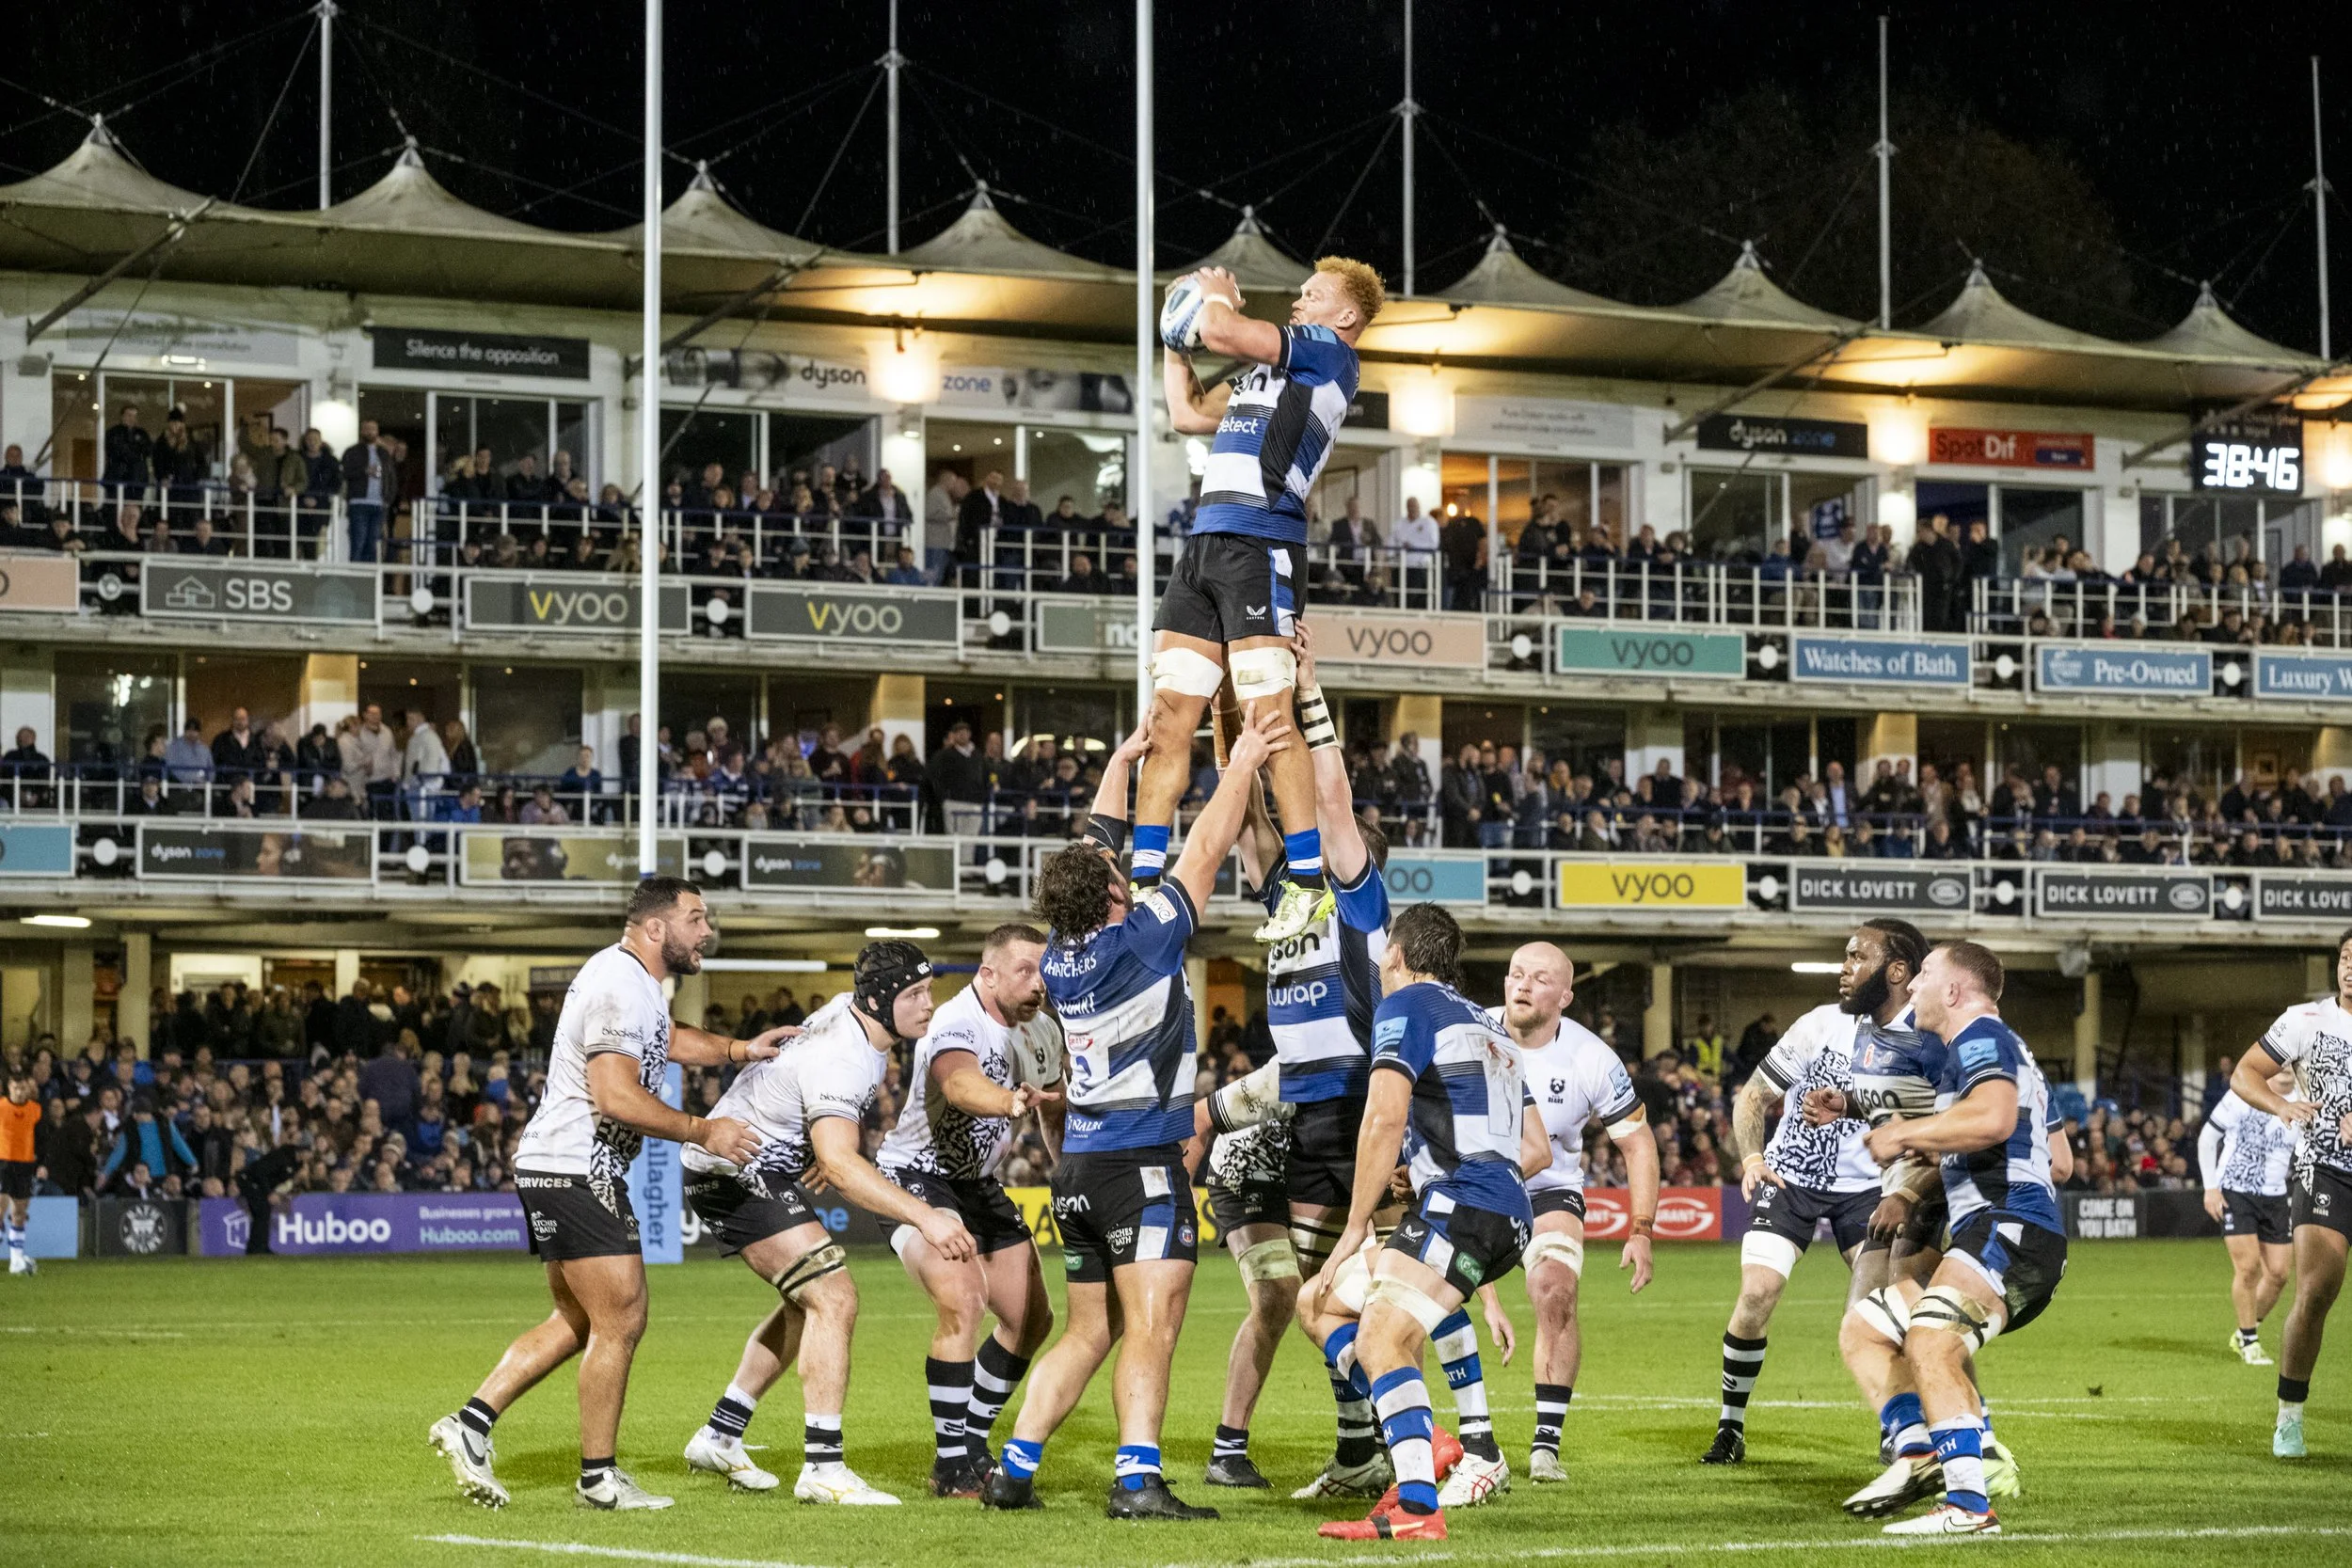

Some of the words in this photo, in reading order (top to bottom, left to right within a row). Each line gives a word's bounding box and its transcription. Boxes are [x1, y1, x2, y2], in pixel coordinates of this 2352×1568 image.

[405, 338, 457, 360] Silence
[459, 341, 483, 361] the
[485, 346, 559, 366] opposition
[802, 361, 866, 388] dyson
[943, 375, 991, 392] zone
[1729, 420, 1787, 449] dyson
[2202, 442, 2299, 491] 38:46
[225, 578, 293, 610] SBS
[529, 591, 628, 623] vyoo
[807, 601, 903, 635] vyoo
[1346, 626, 1433, 657] vyoo
[1612, 638, 1694, 669] vyoo
[1804, 646, 1883, 674] Watches
[1886, 650, 1910, 675] of
[1914, 651, 1958, 677] Bath
[2094, 658, 2198, 686] Pre-Owned
[2268, 664, 2334, 696] Luxury
[151, 842, 192, 863] dyson
[754, 854, 792, 874] dyson
[1388, 867, 1434, 895] oo
[1612, 872, 1694, 902] vyoo
[1801, 879, 1845, 898] DICK
[1849, 879, 1917, 900] LOVETT
[2046, 884, 2090, 904] DICK
[2093, 885, 2159, 905] LOVETT
[2264, 888, 2305, 908] DICK
[1043, 951, 1097, 978] THATCHERS
[643, 1135, 670, 1250] allagher
[1050, 1193, 1091, 1220] yson
[2079, 1198, 2115, 1218] COME
[278, 1212, 391, 1246] Huboo
[420, 1226, 520, 1244] Huboo.com
[531, 1218, 558, 1227] ATCHES
[1445, 1367, 1468, 1383] ATH
[1935, 1436, 1958, 1455] ATH
